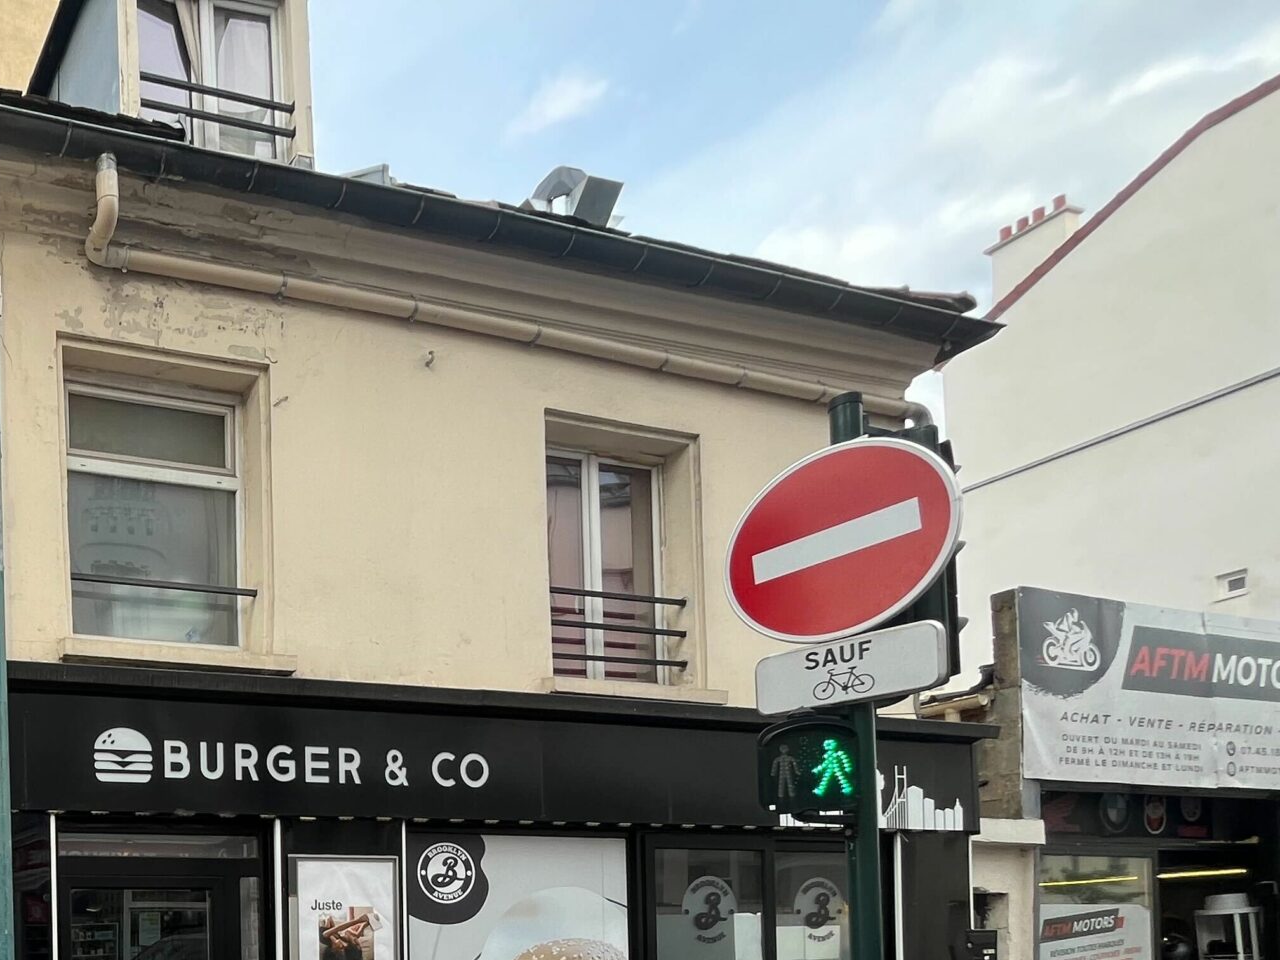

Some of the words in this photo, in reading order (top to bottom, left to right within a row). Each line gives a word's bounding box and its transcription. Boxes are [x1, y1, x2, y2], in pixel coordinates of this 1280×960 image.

[804, 639, 872, 671] SAUF
[1130, 646, 1210, 682] AFTM
[1060, 711, 1111, 724] ACHAT
[1129, 716, 1173, 730] VENTE
[1189, 720, 1273, 735] RÉPARATION
[1062, 733, 1099, 743] OUVERT
[1104, 736, 1117, 744] DU
[1121, 737, 1149, 746] MARDI
[1168, 741, 1201, 750] SAMEDI
[1066, 745, 1078, 754] DE
[163, 739, 362, 785] BURGER
[384, 749, 409, 786] &
[431, 751, 490, 788] CO
[1095, 759, 1107, 767] LE
[1112, 760, 1158, 770] DIMANCHE
[427, 846, 467, 861] BROOKLYN
[432, 888, 463, 900] AVENUE
[311, 899, 343, 910] Juste
[1072, 915, 1116, 934] MOTORS
